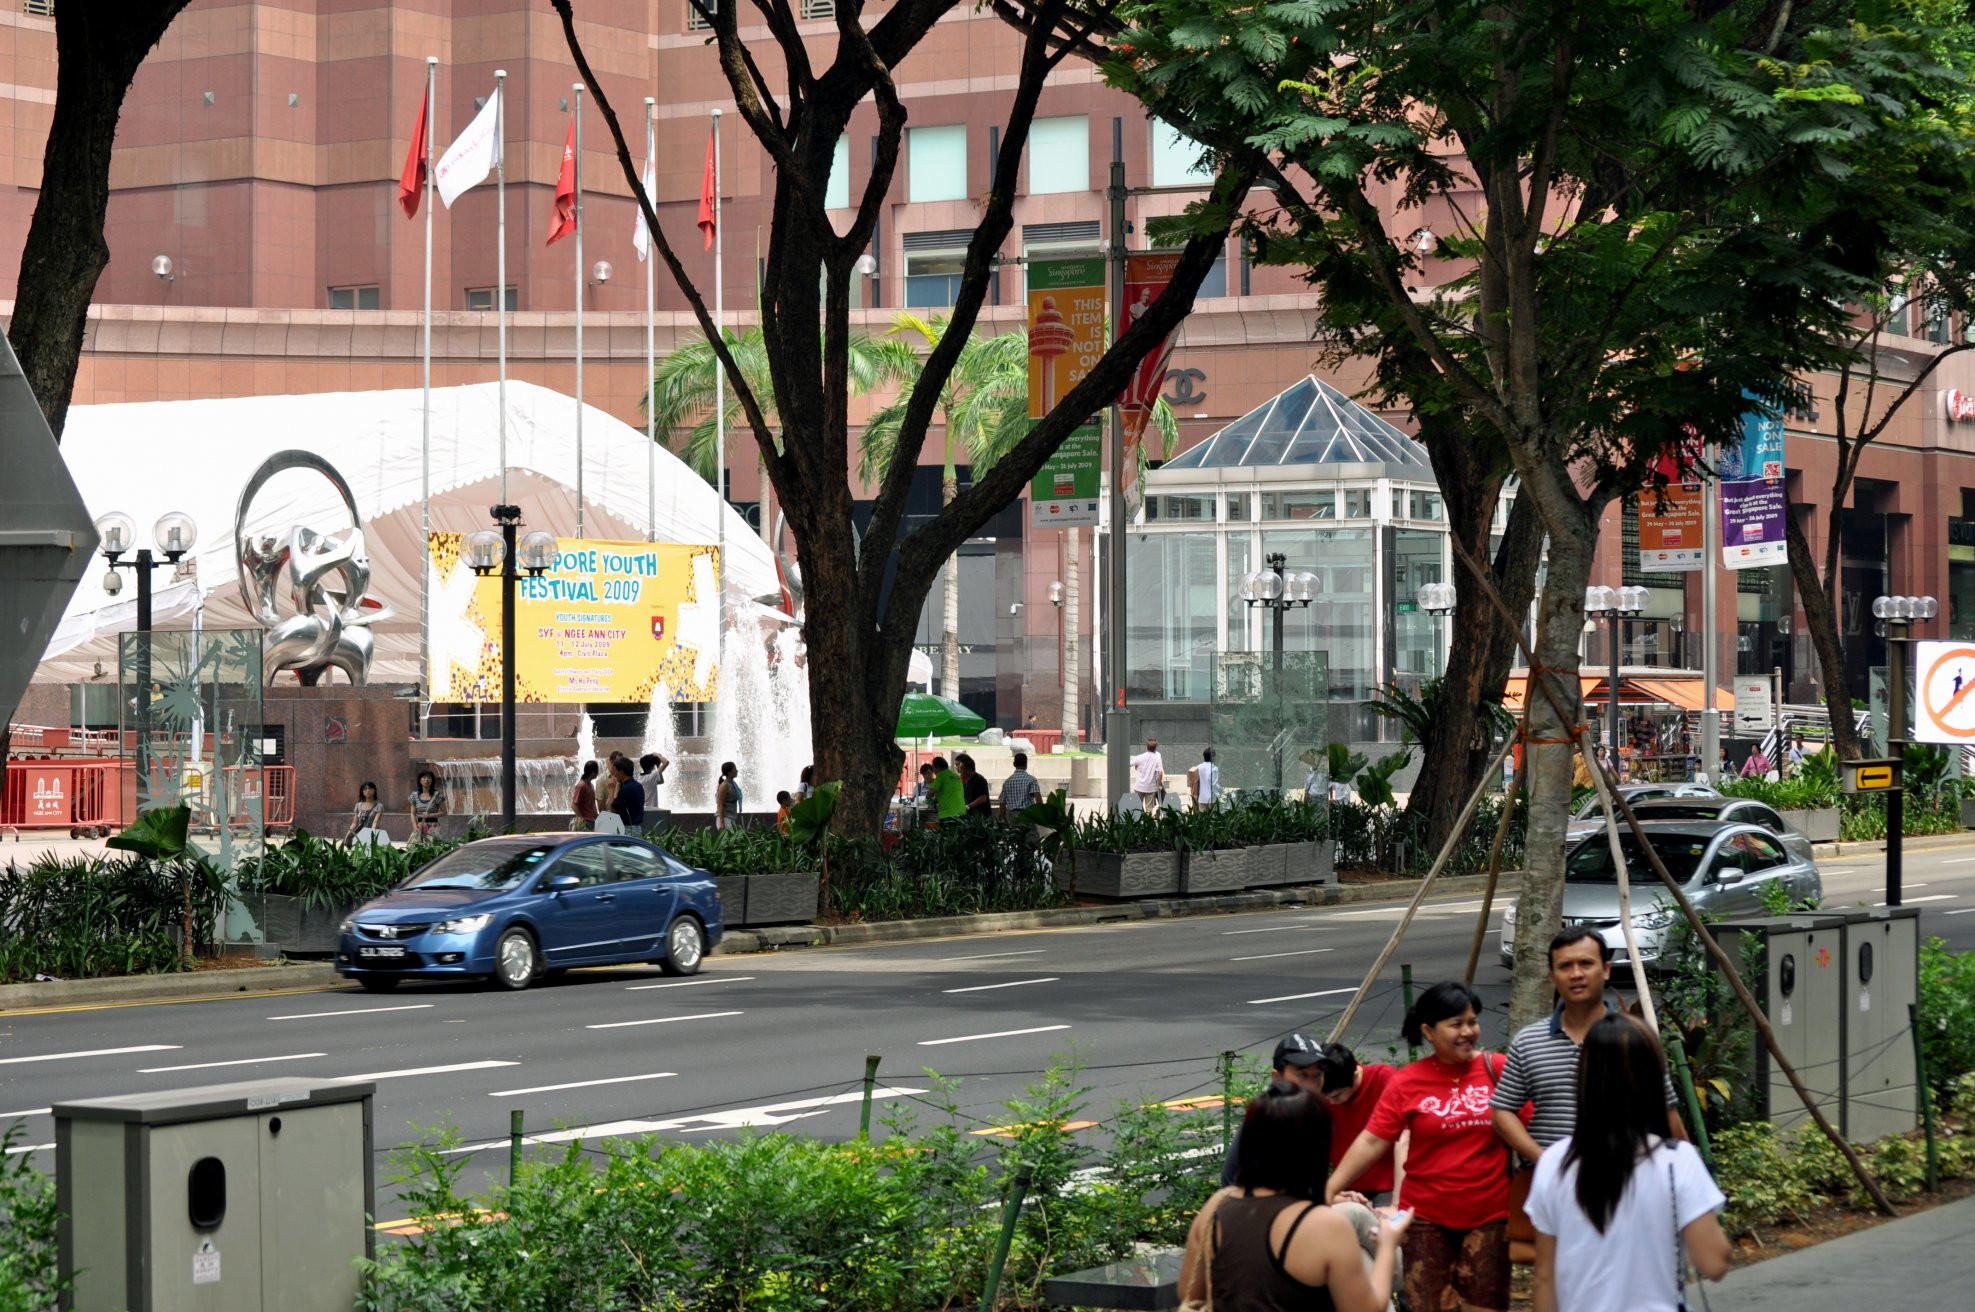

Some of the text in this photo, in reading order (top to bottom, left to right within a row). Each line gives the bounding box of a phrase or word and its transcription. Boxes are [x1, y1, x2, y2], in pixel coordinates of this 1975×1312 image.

[1074, 298, 1102, 310] THIS
[1072, 312, 1102, 325] ITEM
[1091, 327, 1102, 338] IS
[1073, 341, 1102, 352] NOT
[1068, 434, 1100, 442] everything
[1763, 432, 1782, 440] ON
[1756, 442, 1782, 454] SALE
[1050, 450, 1081, 459] ingapore
[1756, 492, 1783, 500] everything
[602, 553, 657, 576] YOUTH
[521, 576, 640, 602] FESTIVAL 2009
[556, 613, 612, 622] YOUTH SIGNATURES
[538, 628, 554, 638] SYF
[564, 629, 586, 638] NGEE
[588, 630, 606, 639] ANN
[608, 630, 626, 639] CITY
